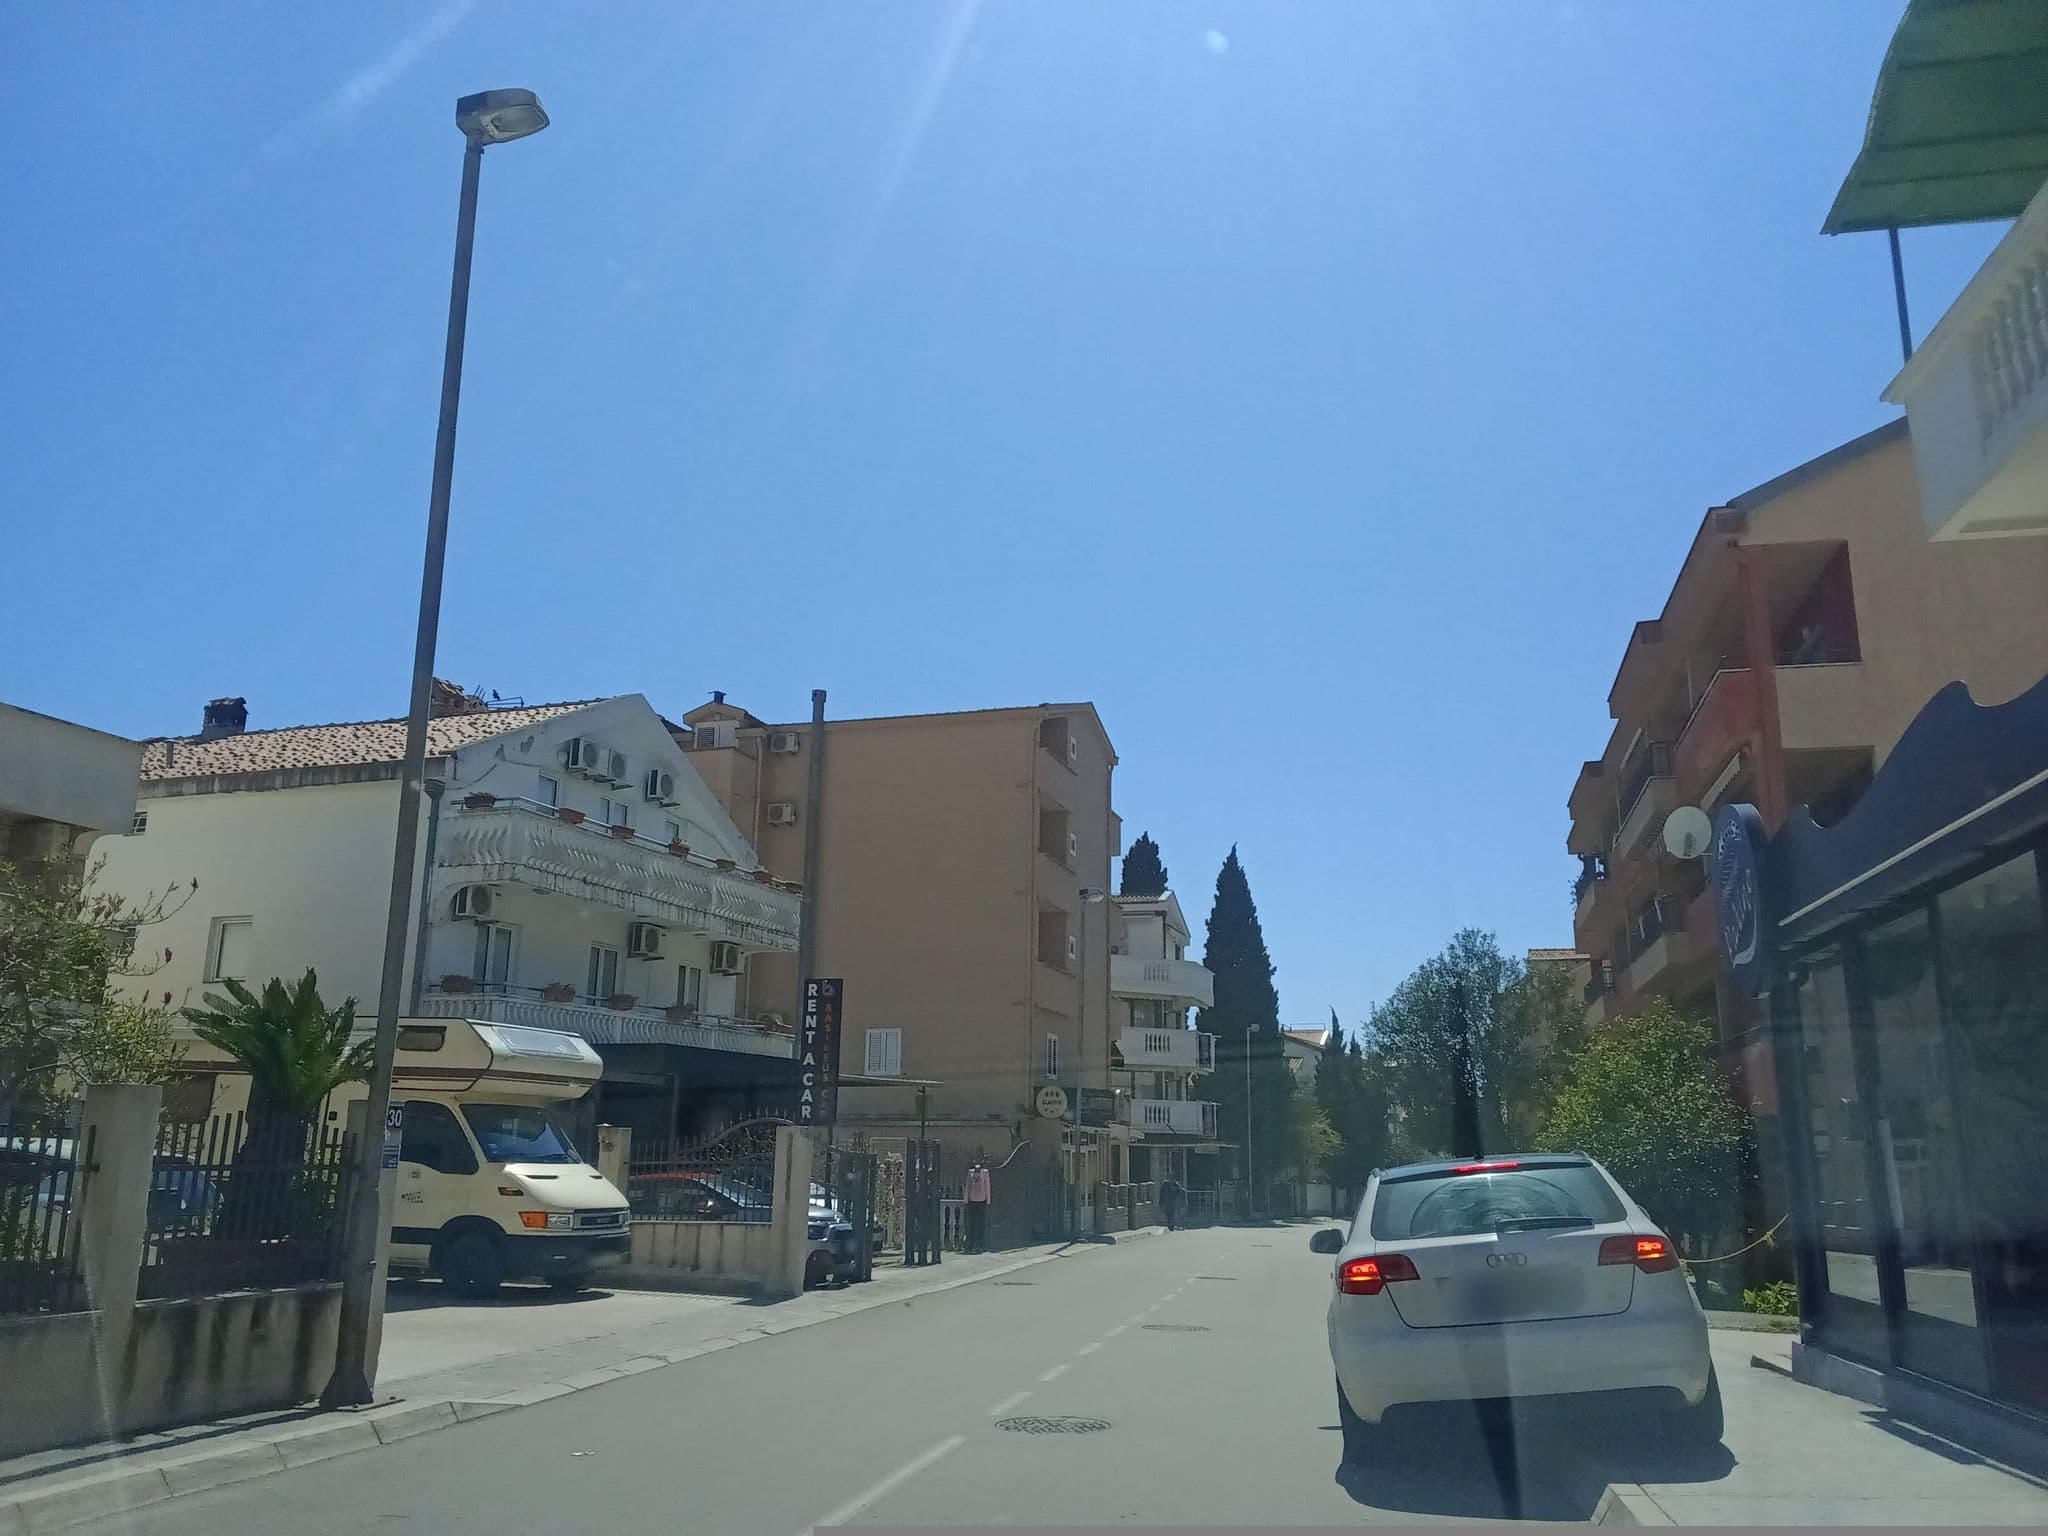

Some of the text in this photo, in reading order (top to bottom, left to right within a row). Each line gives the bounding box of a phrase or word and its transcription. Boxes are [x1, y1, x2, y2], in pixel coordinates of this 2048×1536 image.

[801, 983, 818, 1119] RENT A CAR
[387, 1109, 402, 1127] 30
